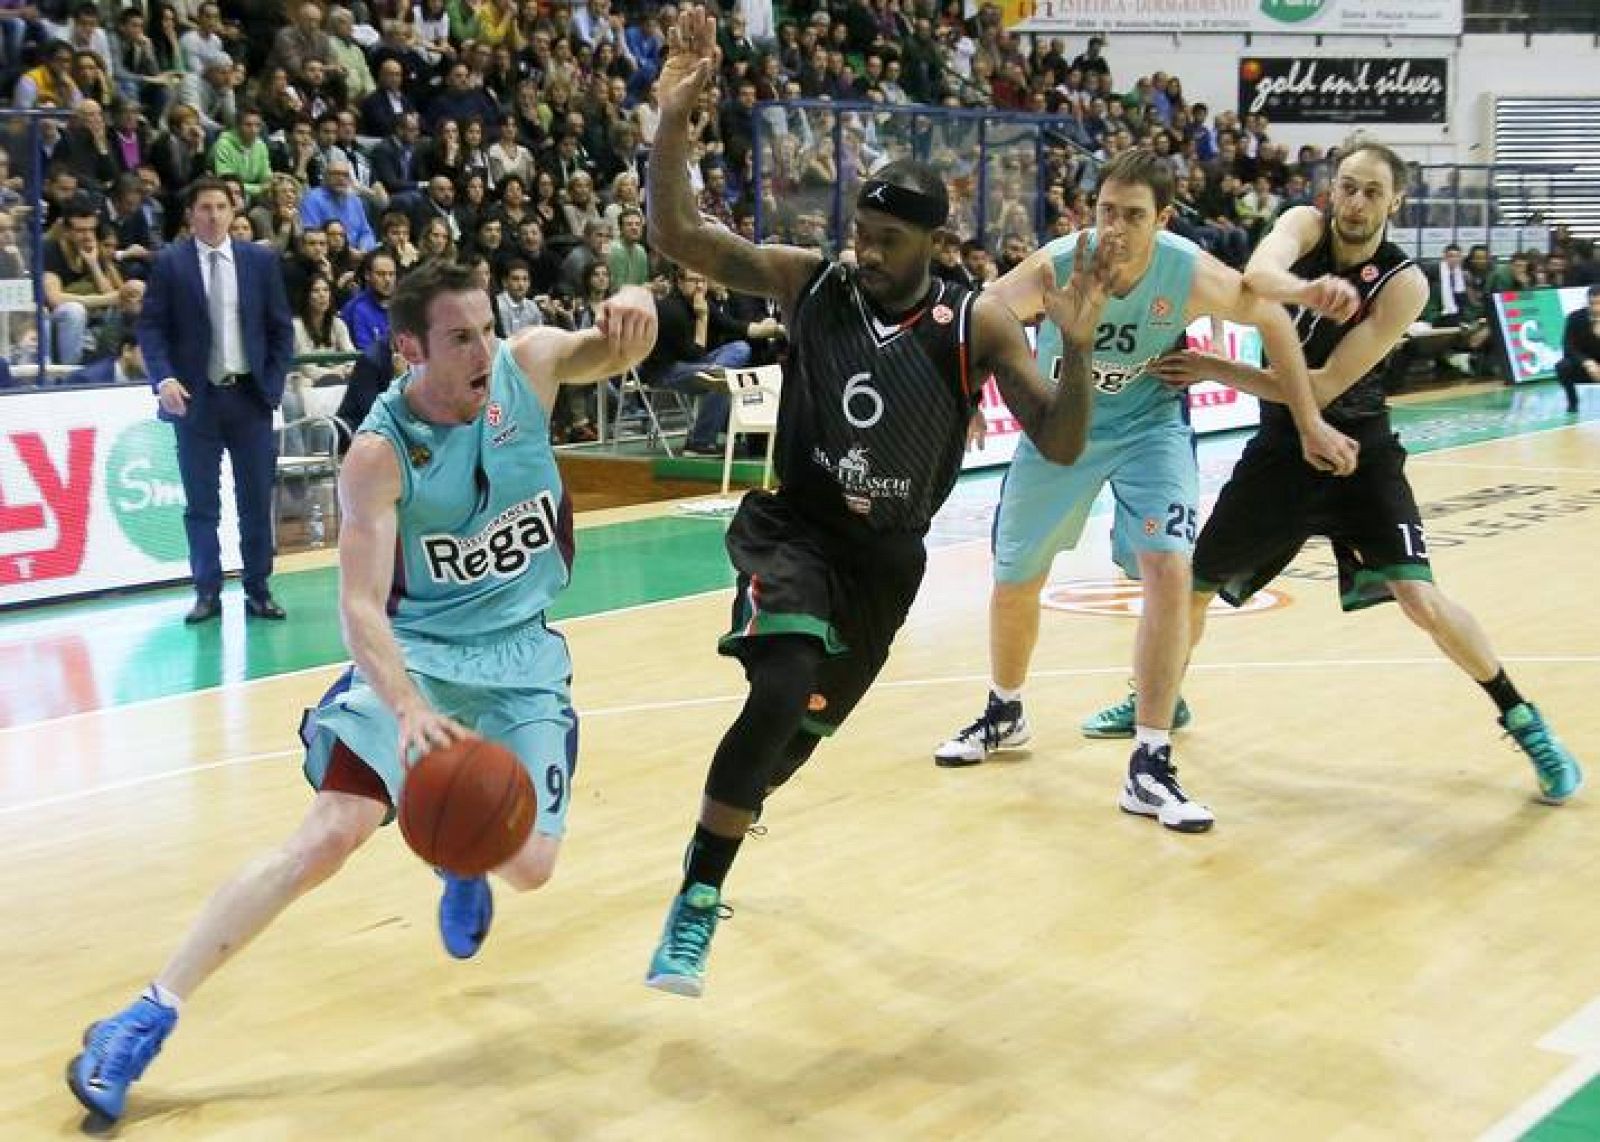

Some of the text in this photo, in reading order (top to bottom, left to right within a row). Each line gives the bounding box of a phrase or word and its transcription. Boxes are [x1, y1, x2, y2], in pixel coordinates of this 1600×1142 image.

[1249, 60, 1318, 113] gold
[1320, 62, 1370, 94] and
[1094, 322, 1138, 354] 25
[843, 372, 885, 428] 6
[423, 494, 557, 581] Regal
[1166, 502, 1196, 544] 25
[545, 764, 564, 814] 9
